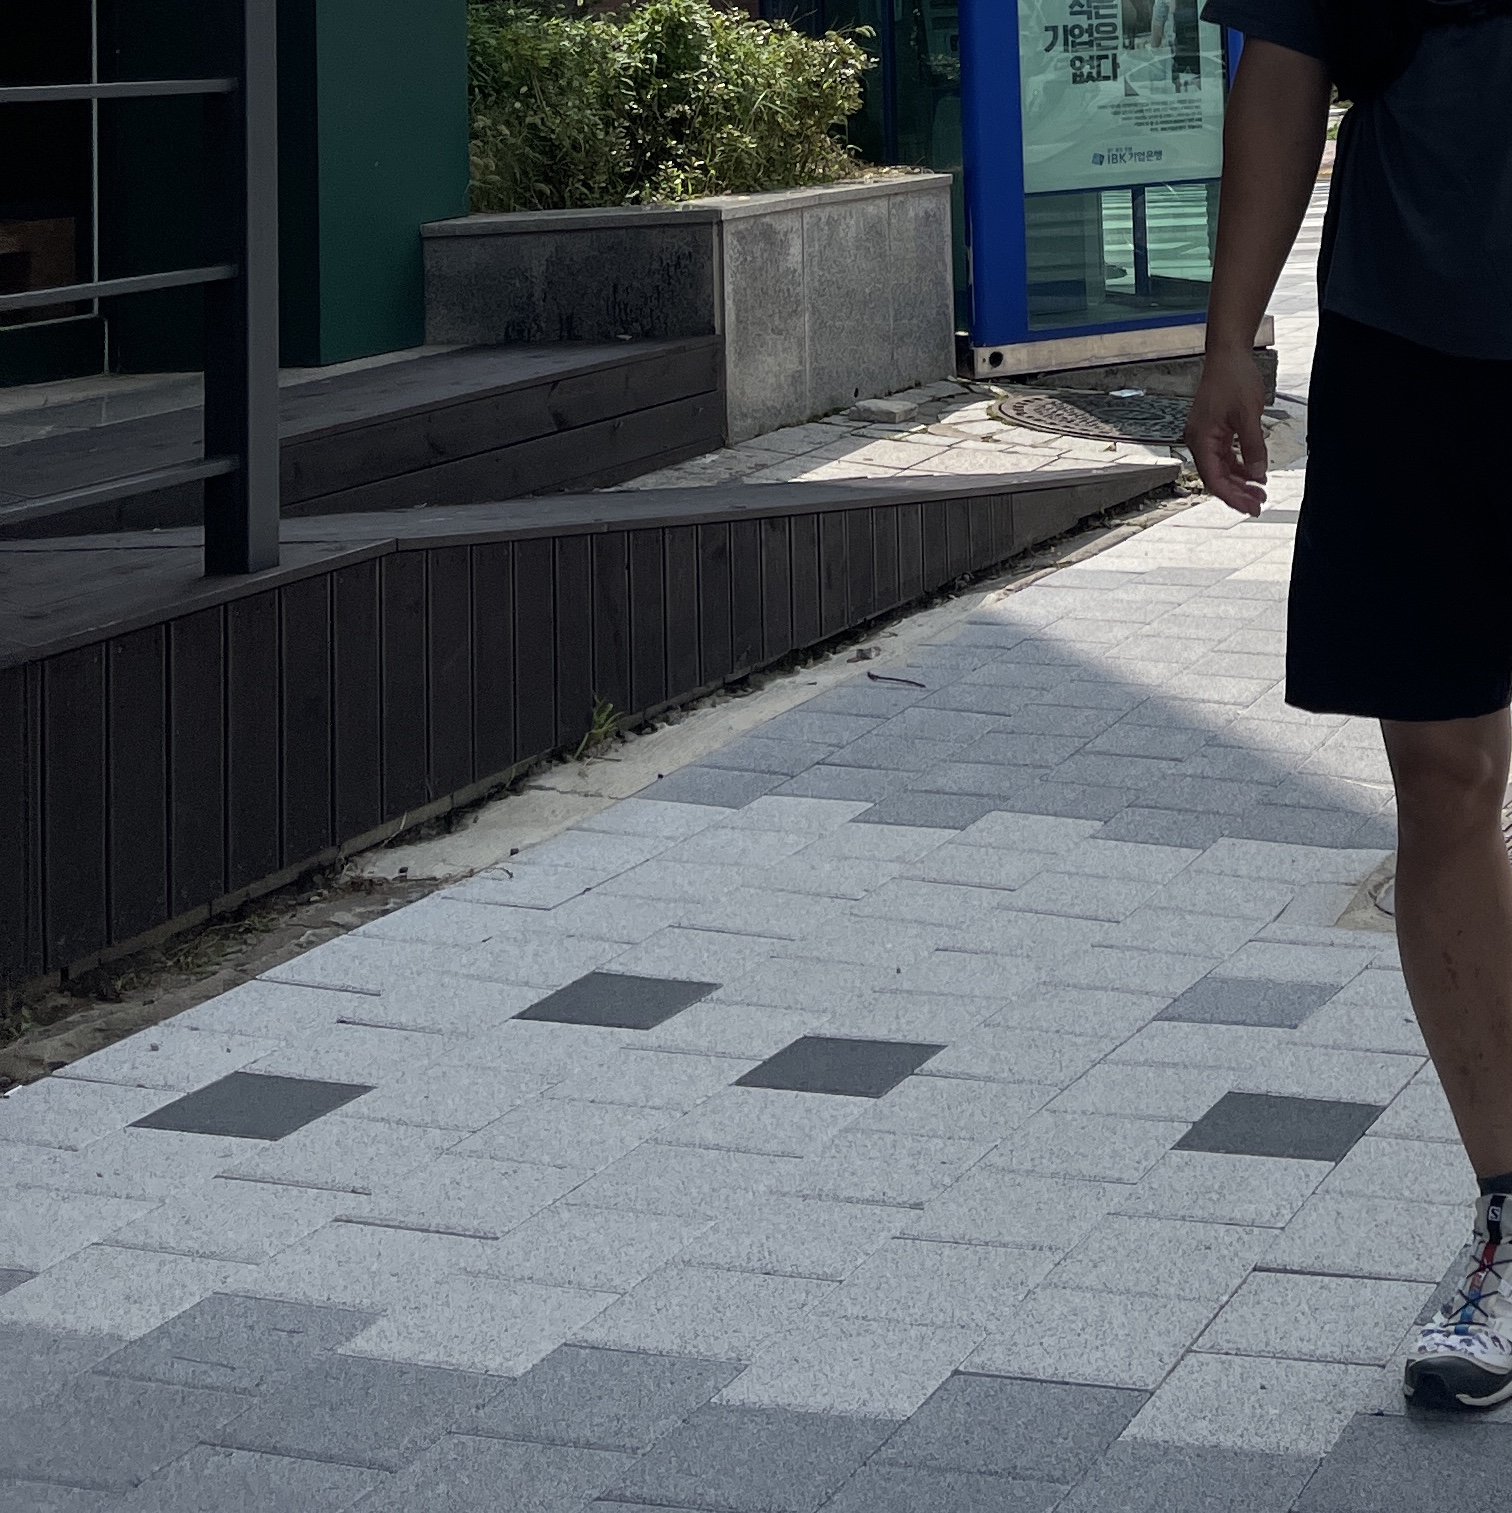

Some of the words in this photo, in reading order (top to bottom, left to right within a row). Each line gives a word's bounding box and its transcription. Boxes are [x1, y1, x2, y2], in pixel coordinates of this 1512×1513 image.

[1044, 21, 1120, 54] 기업은
[1069, 53, 1121, 85] 없다
[1107, 149, 1163, 166] IBK기업은행
